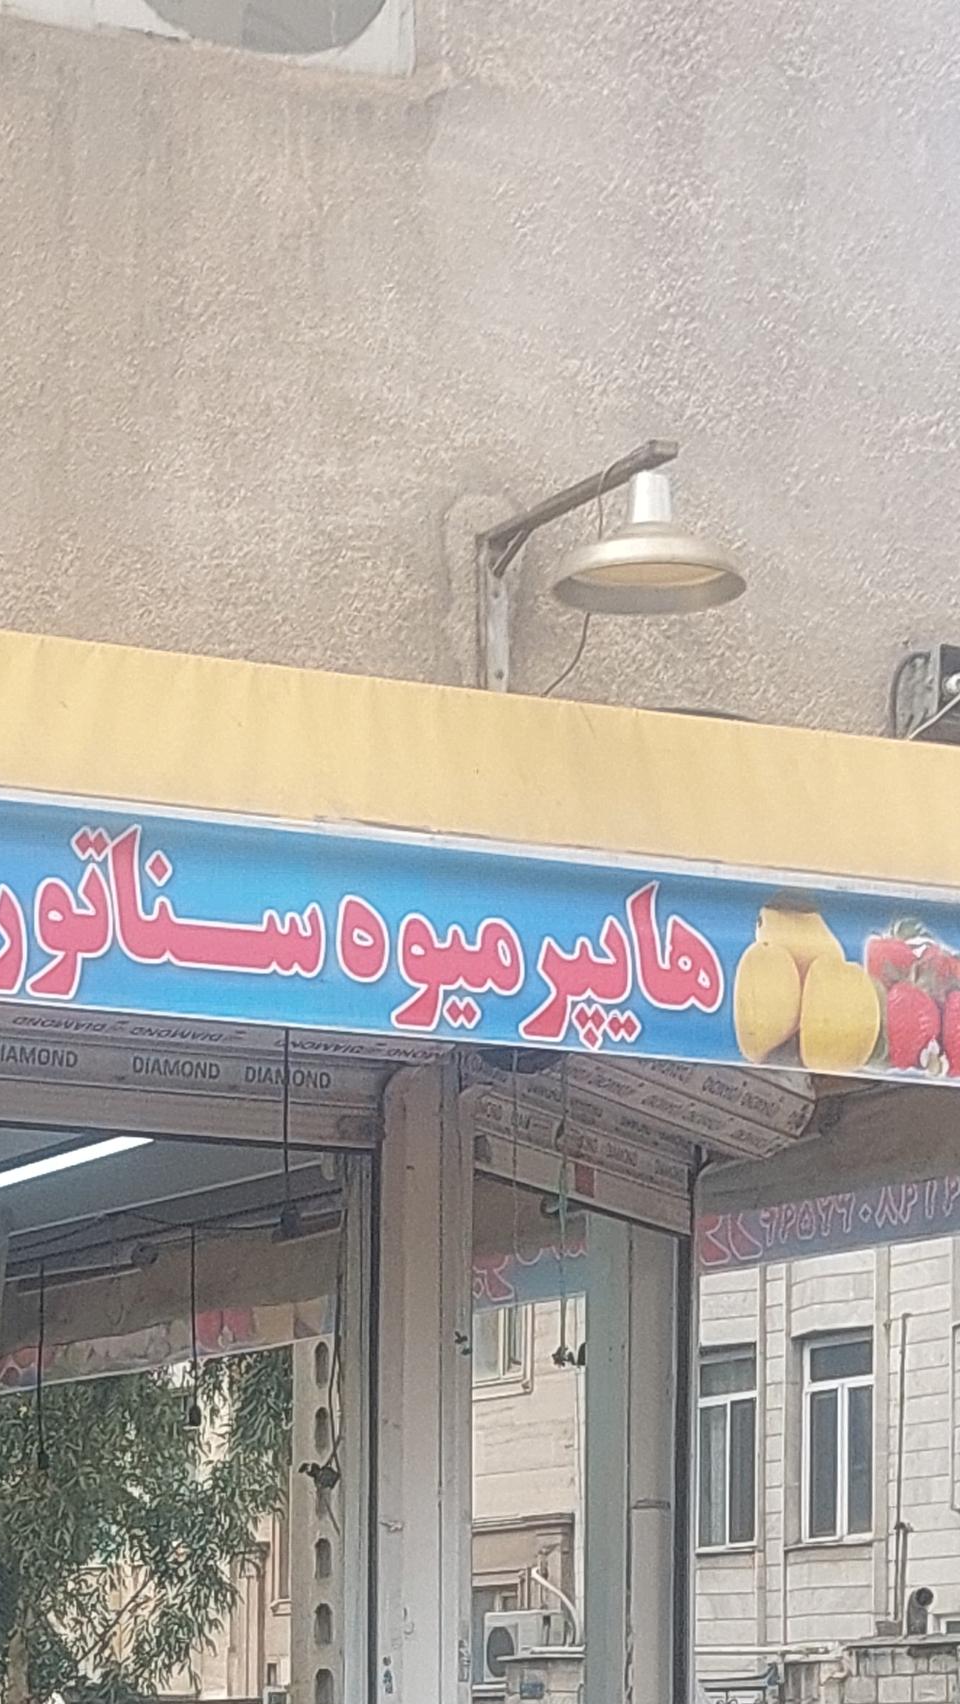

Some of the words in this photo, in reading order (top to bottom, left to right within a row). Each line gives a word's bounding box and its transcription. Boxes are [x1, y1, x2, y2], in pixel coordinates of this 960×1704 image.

[335, 893, 525, 1031] میوه
[518, 879, 724, 1051] هایپر
[132, 1055, 220, 1081] DIAMOND
[244, 1065, 332, 1090] DIAMOND
